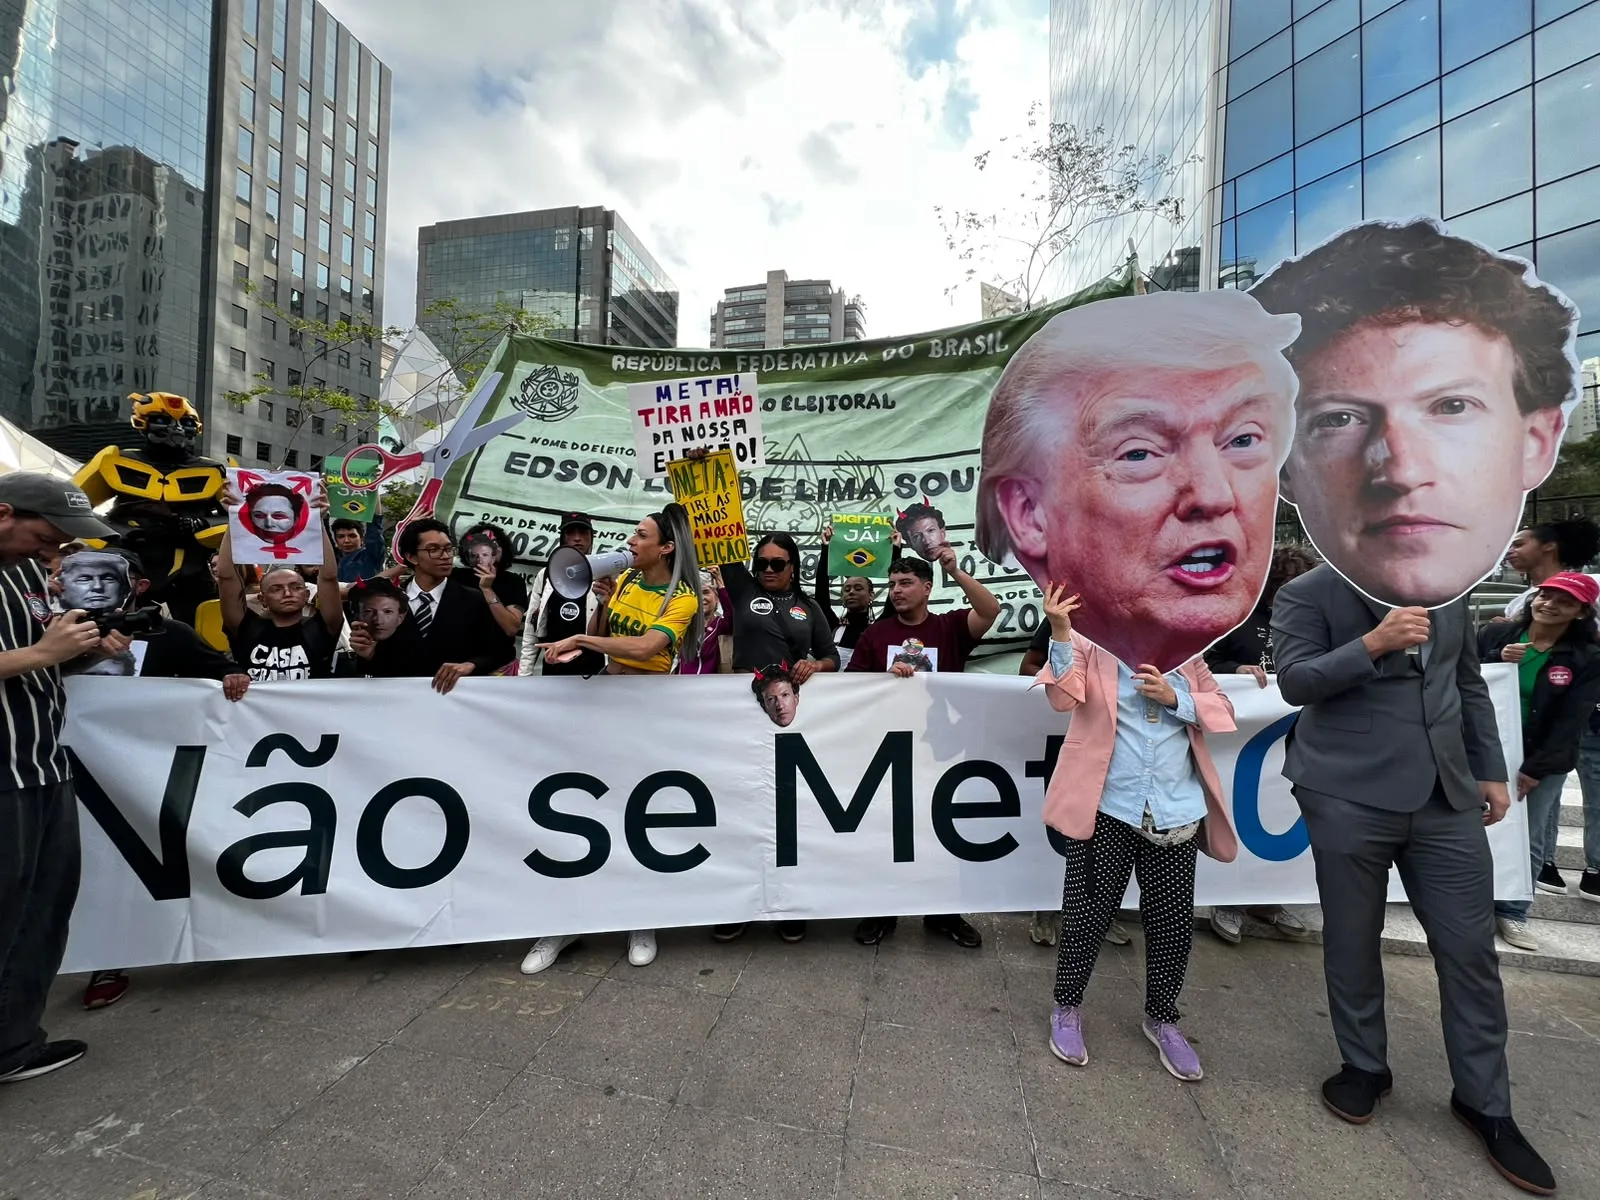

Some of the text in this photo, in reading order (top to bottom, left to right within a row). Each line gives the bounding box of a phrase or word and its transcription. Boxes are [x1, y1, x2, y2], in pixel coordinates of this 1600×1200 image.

[612, 330, 1009, 373] REPÚBLICA FEDERATIVA DO BRASIL
[656, 375, 740, 402] META!
[637, 404, 692, 427] TIRA
[699, 402, 711, 420] A
[713, 390, 753, 418] MÃO
[781, 393, 896, 414] ELEITORAL
[652, 418, 747, 445] DA NOSSA
[530, 436, 636, 457] NOME DO ELEITO
[503, 450, 633, 490] EDSON
[794, 476, 884, 502] LIMA
[893, 466, 980, 499] SOU
[716, 491, 731, 508] AS
[482, 513, 513, 527] DATA
[518, 518, 537, 530] DE
[704, 521, 744, 539] NOSSA
[832, 513, 891, 526] DIGITAL
[843, 527, 880, 543] JÁ!
[694, 537, 748, 565] LEIÇÃO
[250, 643, 309, 669] CASA
[64, 732, 471, 902] Não
[522, 768, 717, 879] se
